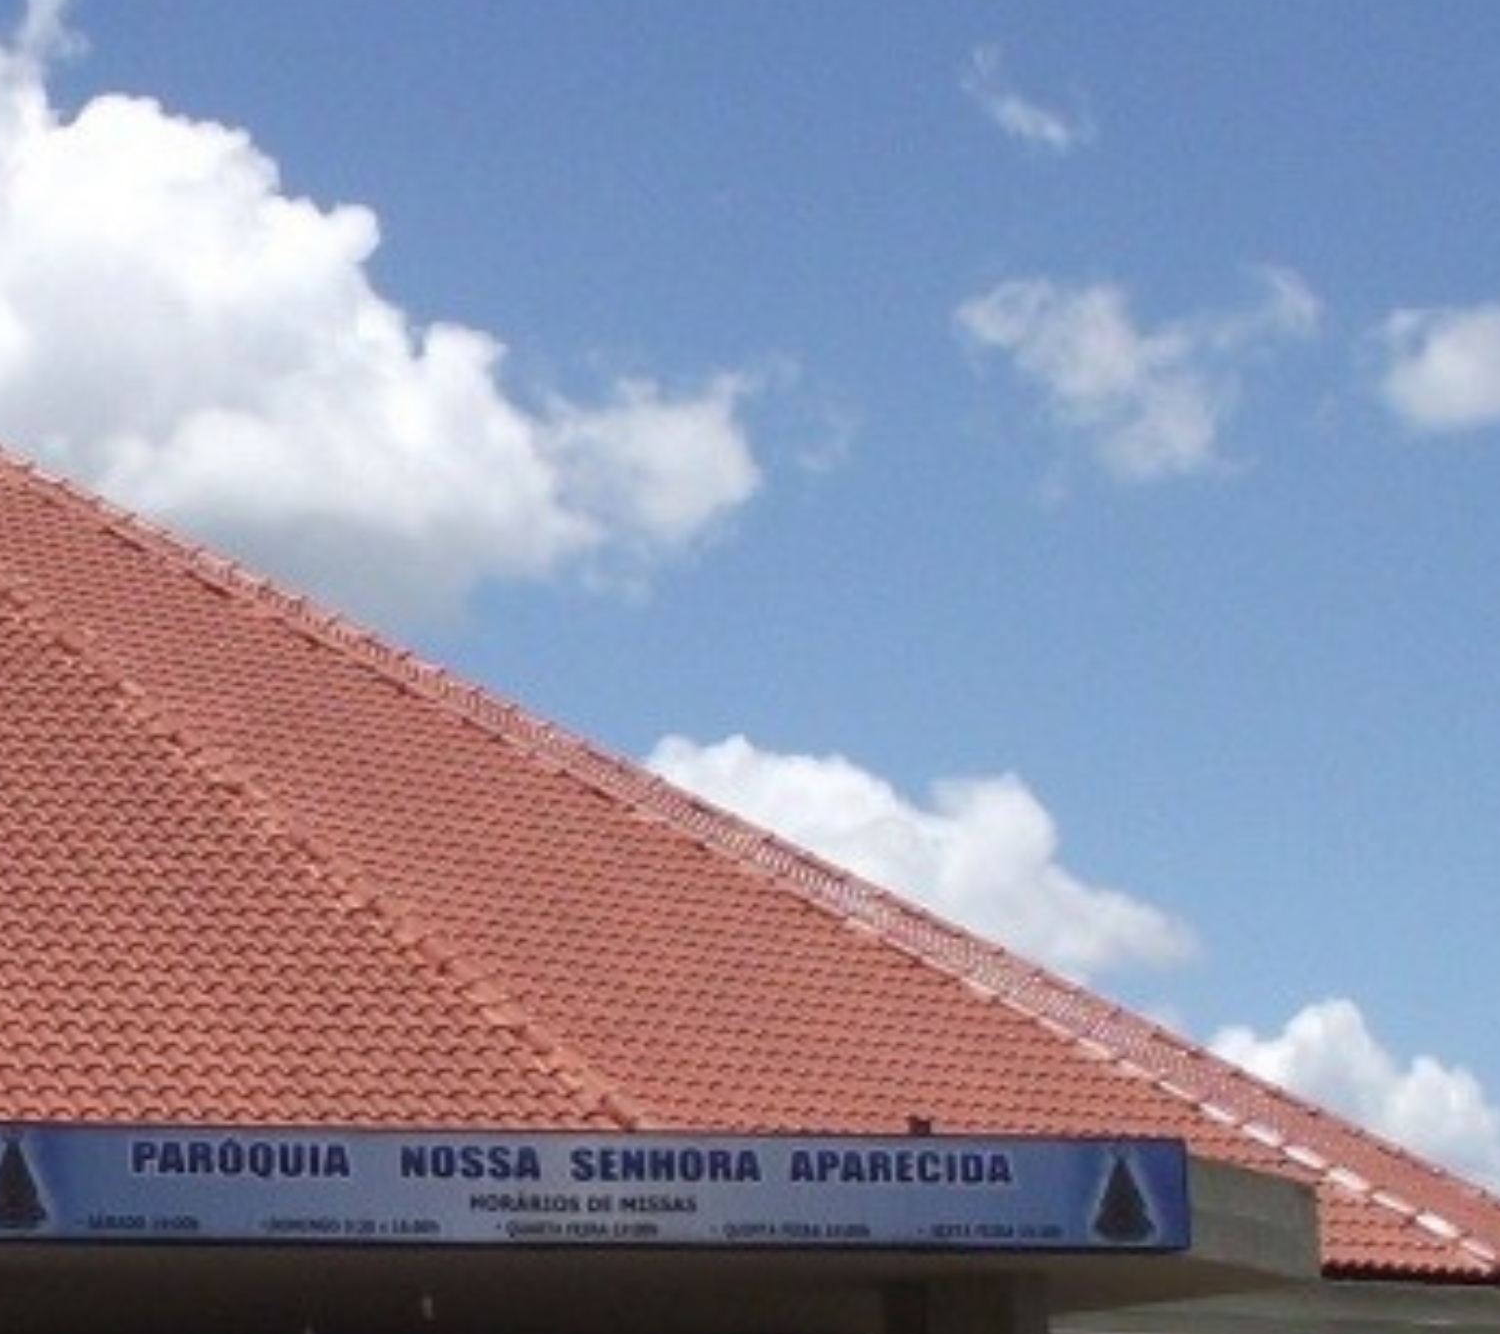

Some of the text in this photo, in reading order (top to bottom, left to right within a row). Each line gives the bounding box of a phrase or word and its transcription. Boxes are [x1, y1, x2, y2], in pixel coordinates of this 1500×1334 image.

[131, 1137, 1013, 1185] PARÓQUIA NOSSA SENHORA APARECIDA
[470, 1190, 698, 1214] HORÁRIOS DE MISSAS
